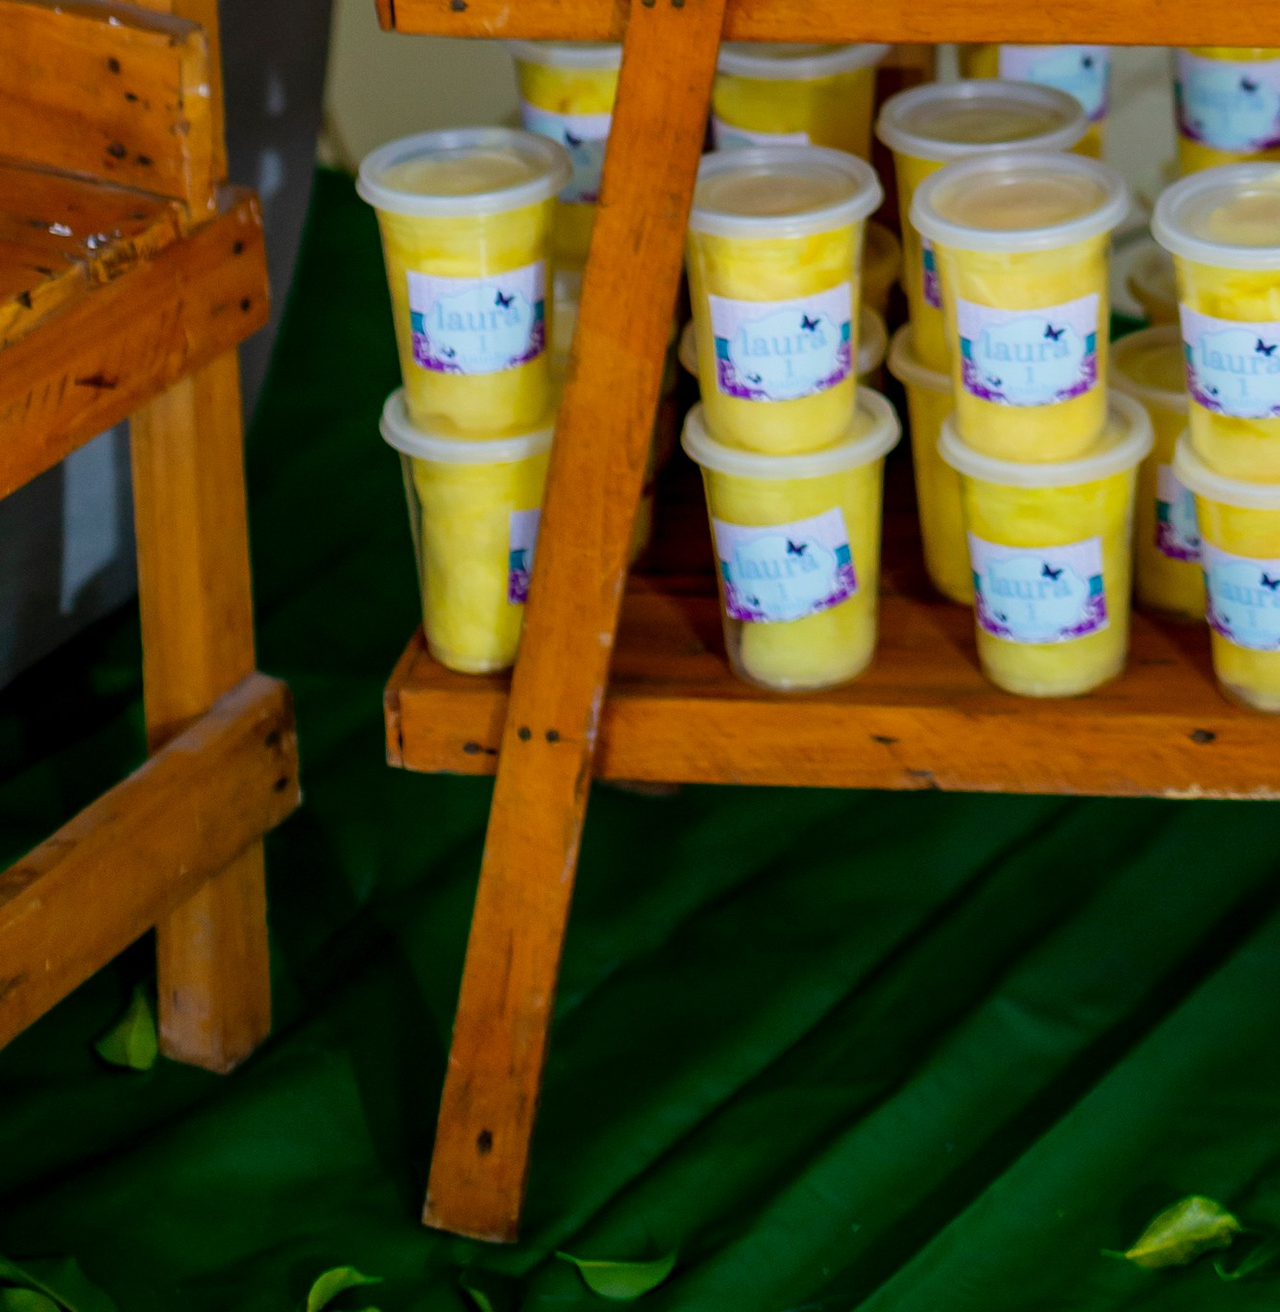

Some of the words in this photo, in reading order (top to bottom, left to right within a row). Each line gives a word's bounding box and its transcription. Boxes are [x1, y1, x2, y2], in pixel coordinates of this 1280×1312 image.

[435, 299, 521, 331] laura
[741, 326, 827, 357] laura
[983, 328, 1069, 362] laura
[735, 545, 820, 579] laura
[986, 561, 1073, 599] laura
